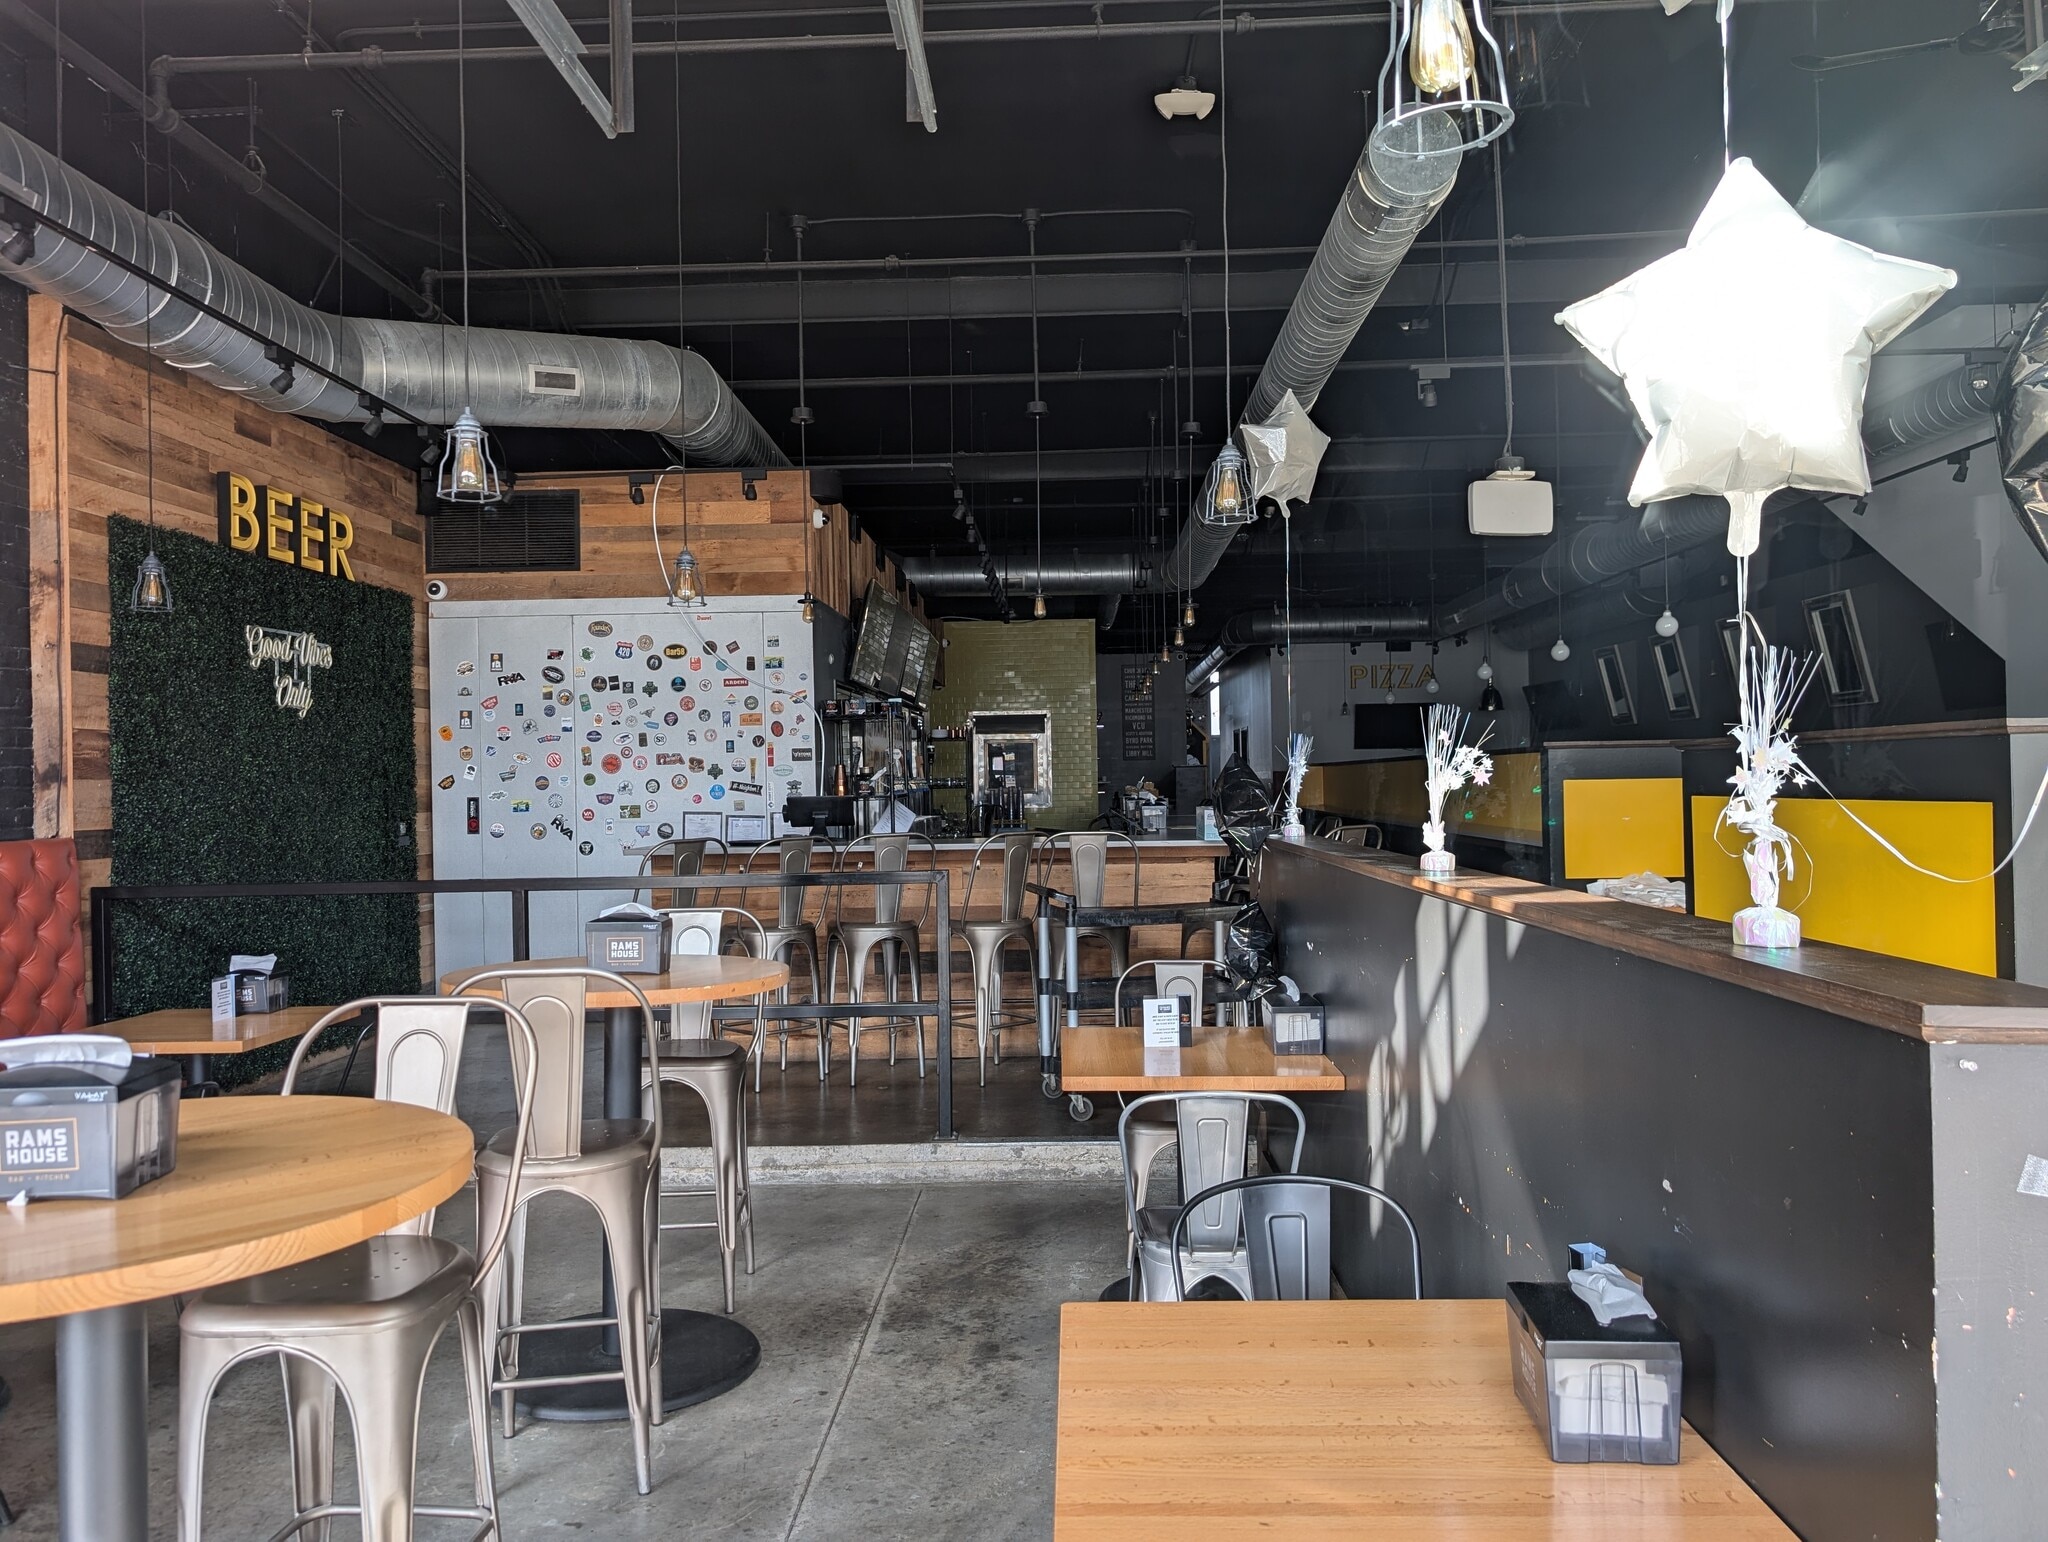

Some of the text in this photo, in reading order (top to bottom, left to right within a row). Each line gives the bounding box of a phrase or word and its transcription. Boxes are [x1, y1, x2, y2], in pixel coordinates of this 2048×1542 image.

[222, 471, 356, 582] BEER
[246, 624, 333, 670] Good Vibes
[618, 646, 630, 657] 420
[665, 647, 685, 656] Bar58
[1349, 663, 1436, 689] PIZZA
[274, 674, 314, 720] Only
[1132, 722, 1146, 730] VCU
[550, 817, 574, 842] RVA
[611, 941, 639, 951] RAMS
[611, 950, 639, 958] HOUSE
[5, 1127, 68, 1149] RAMS
[6, 1146, 69, 1165] HOUSE
[35, 1173, 70, 1181] KITCHEN
